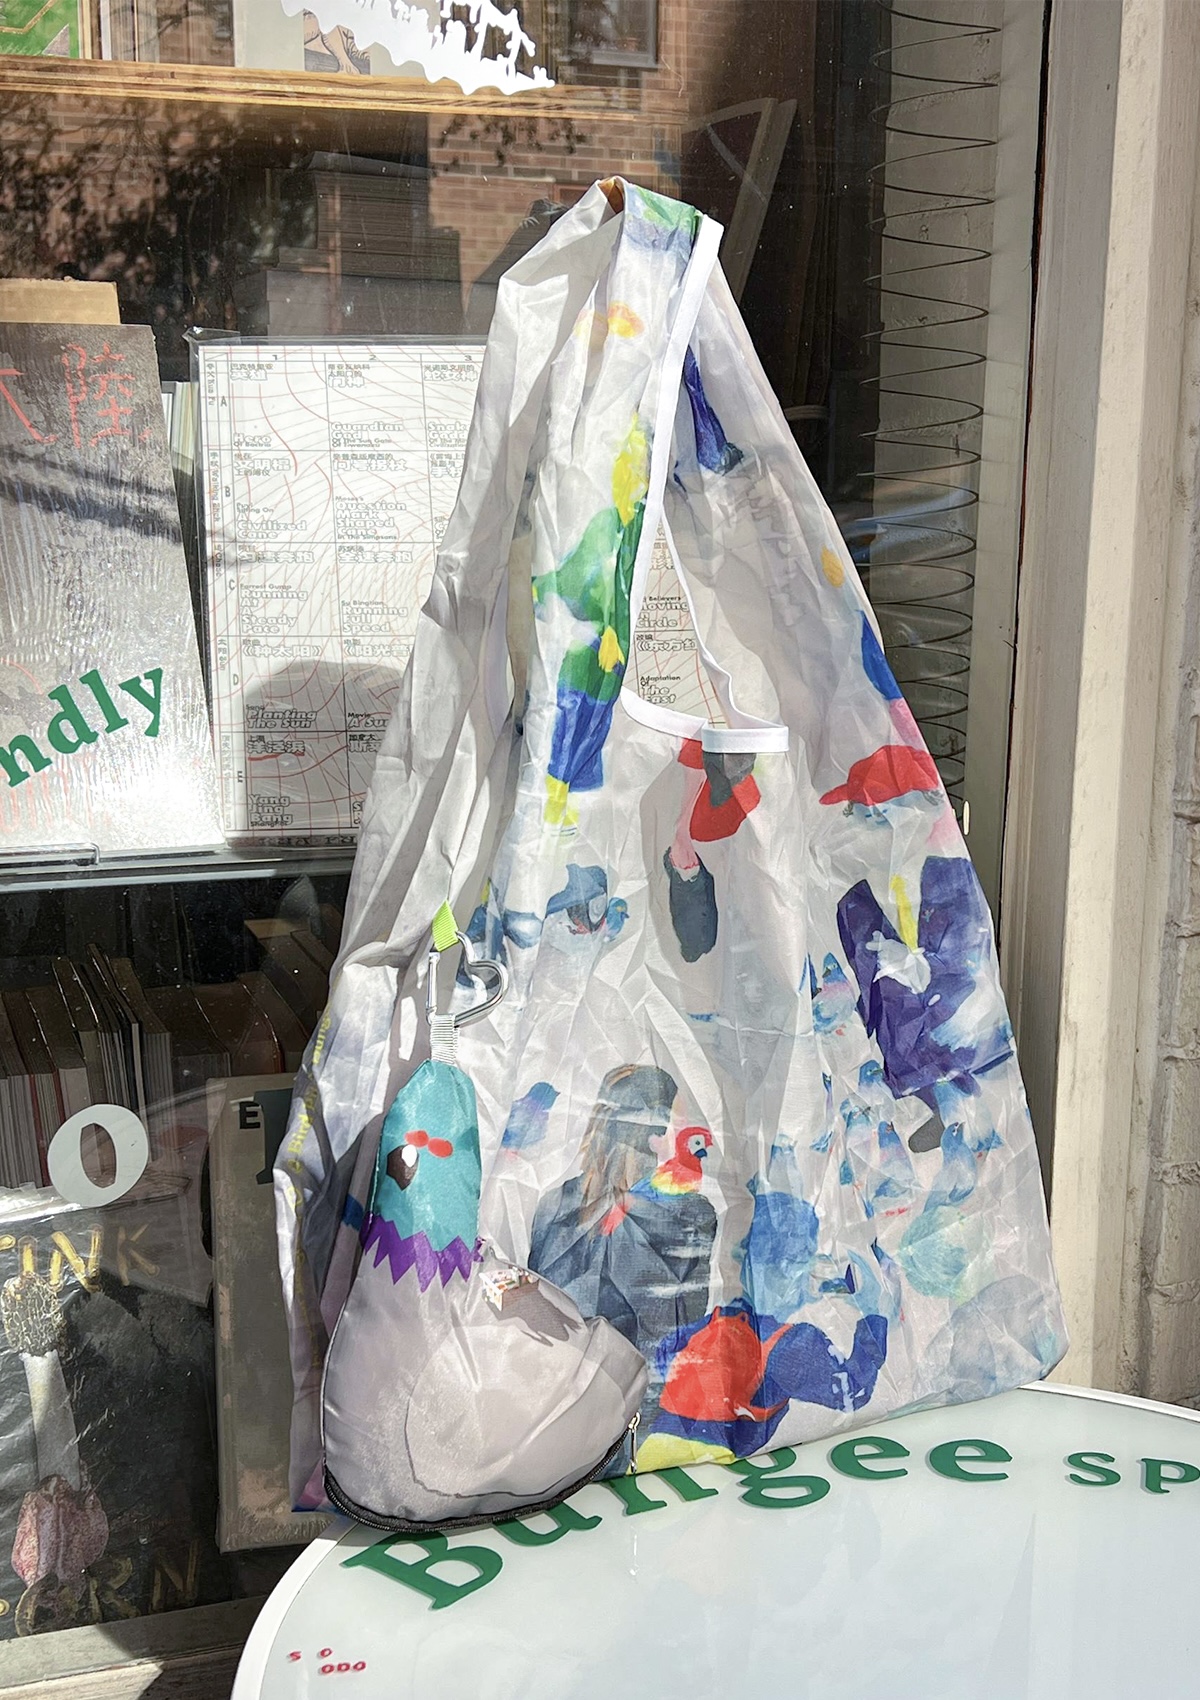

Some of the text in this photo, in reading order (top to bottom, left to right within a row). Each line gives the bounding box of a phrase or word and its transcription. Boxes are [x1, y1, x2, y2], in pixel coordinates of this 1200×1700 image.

[220, 395, 227, 407] A
[331, 421, 404, 432] Guardian
[233, 432, 272, 444] Hero
[331, 430, 363, 440] God
[224, 486, 231, 497] B
[336, 500, 407, 511] Question
[336, 510, 379, 519] Mark
[237, 520, 307, 531] Civilized
[337, 518, 394, 529] Shaped
[238, 530, 278, 539] Cane
[337, 527, 378, 536] Cane
[229, 579, 235, 590] C
[241, 590, 308, 601] Running
[241, 598, 259, 607] At
[342, 606, 408, 617] Running
[242, 615, 297, 627] Steady
[343, 614, 372, 623] Full
[636, 616, 678, 628] Circle
[242, 624, 280, 633] Pace
[343, 622, 390, 635] Speed
[344, 644, 412, 657] 《阳光普
[233, 673, 239, 686] D
[641, 685, 670, 696] The
[247, 708, 318, 721] Planting
[247, 719, 312, 729] The Sun
[348, 717, 360, 729] A
[237, 770, 243, 783] E
[249, 794, 291, 806] Yang
[249, 804, 284, 815] Jing
[250, 812, 293, 825] Bang
[0, 1223, 160, 1293] INK
